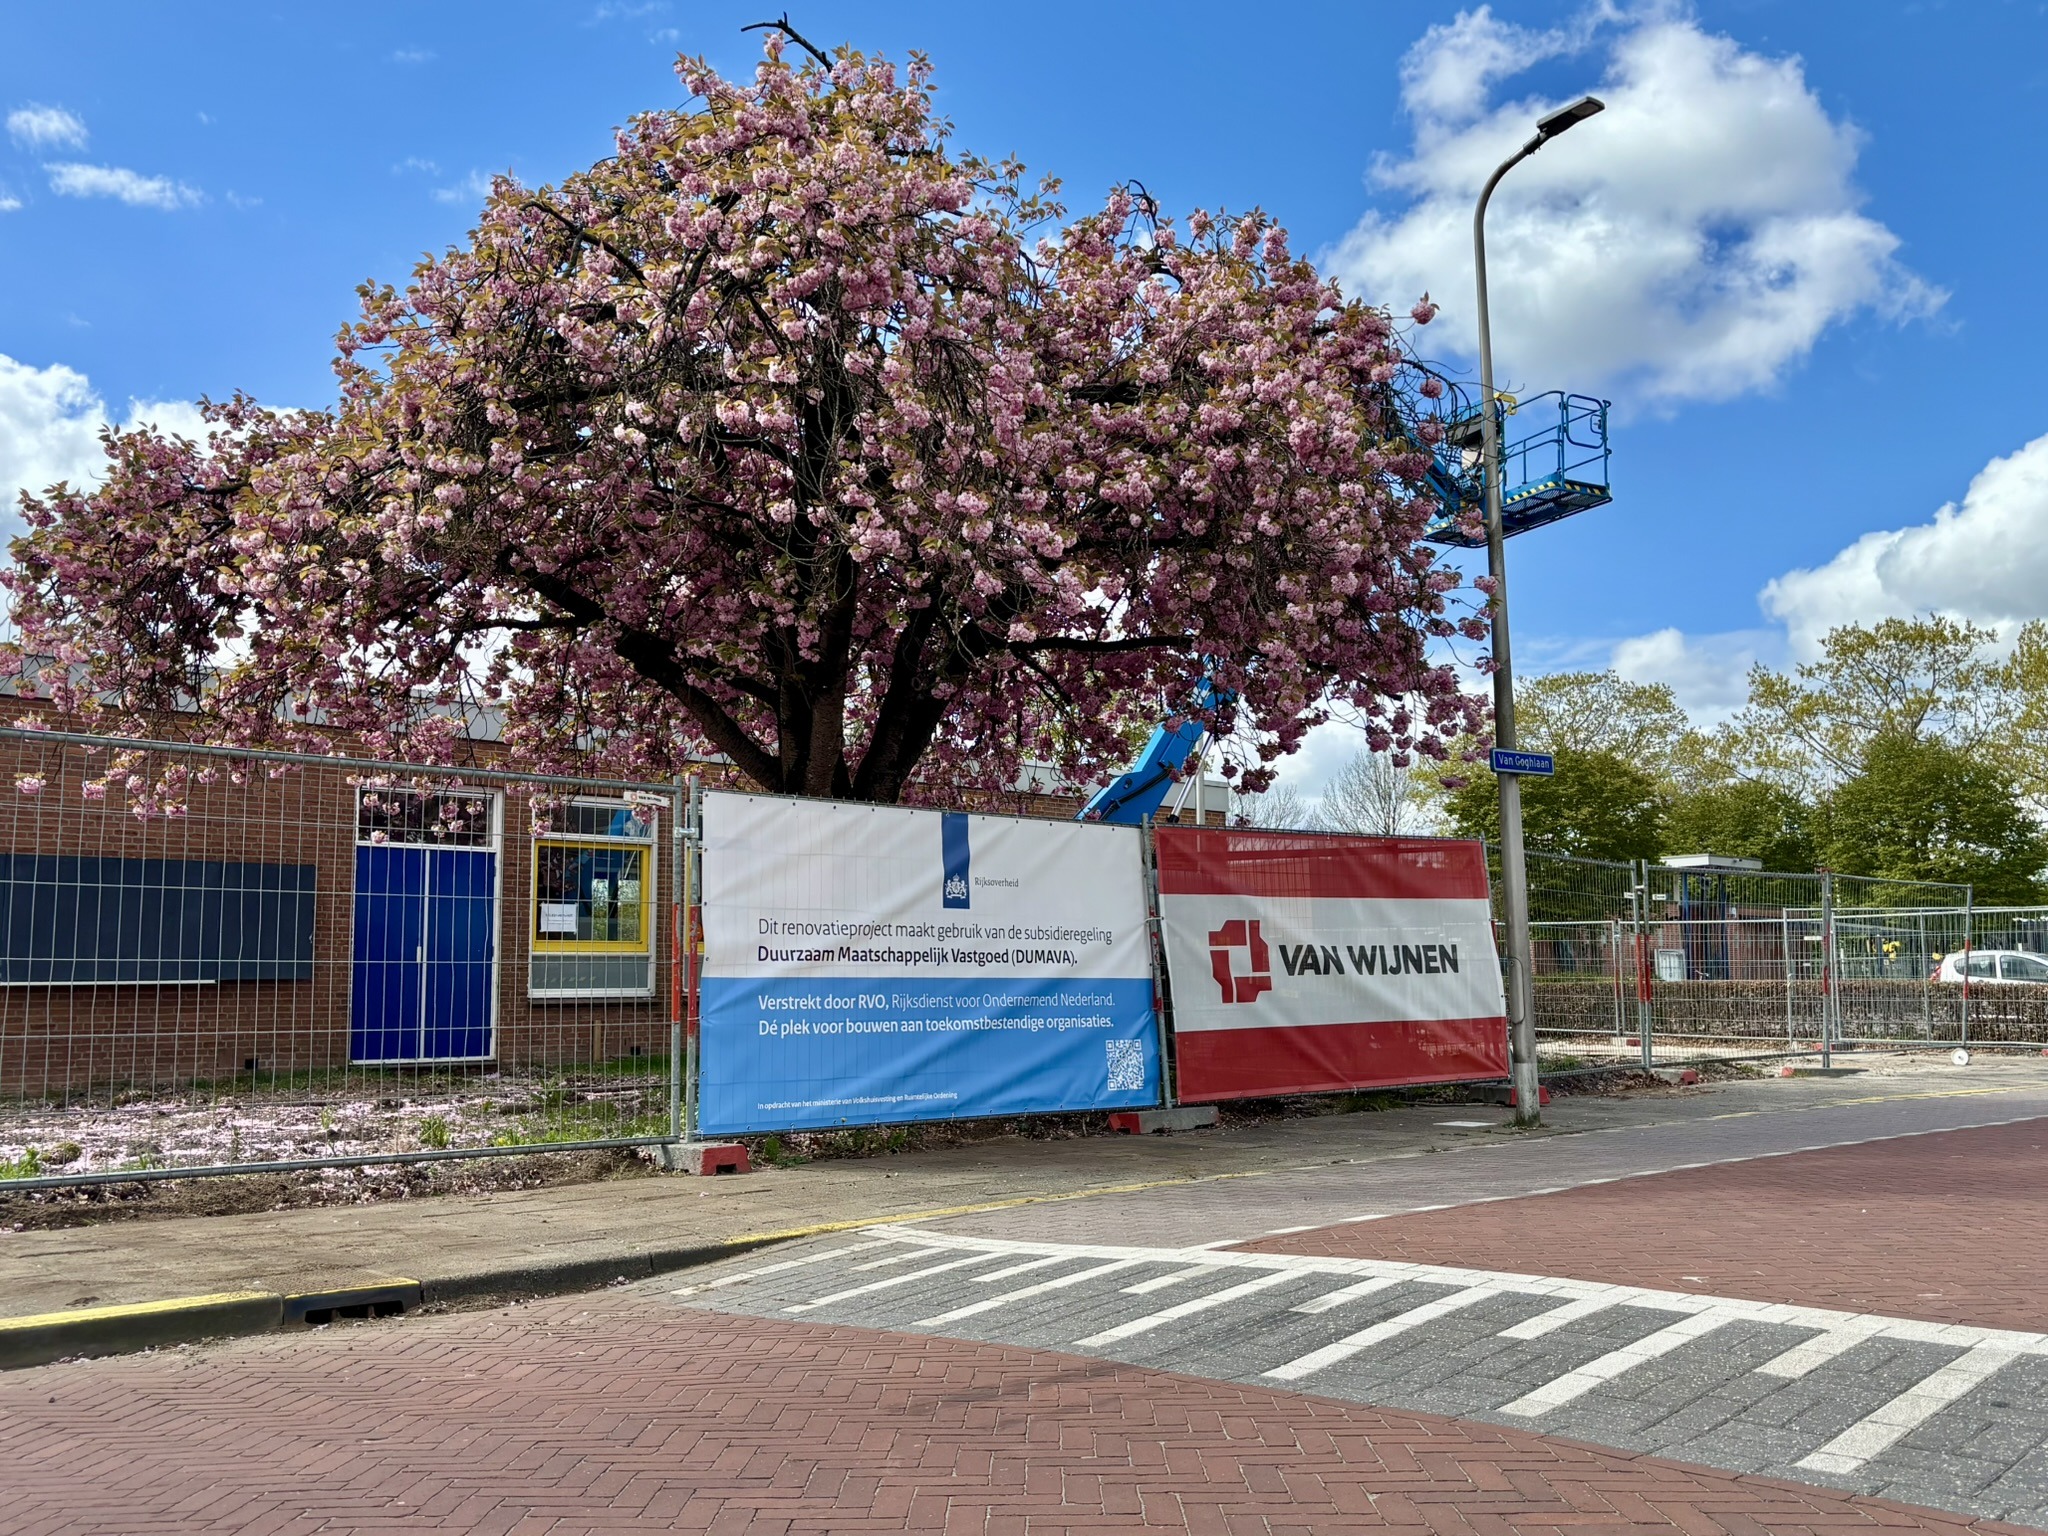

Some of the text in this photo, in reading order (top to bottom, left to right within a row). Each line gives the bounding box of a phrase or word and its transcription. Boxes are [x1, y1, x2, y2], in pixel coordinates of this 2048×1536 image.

[1498, 753, 1550, 770] Van Goghlaan
[974, 876, 1019, 888] Rijksoverheid
[758, 917, 1112, 945] Dit renovatieproject maakt gebruik van de subsidieregeling
[758, 945, 1078, 967] Duurzaam Maatschappelijk Vastgoed (DUMAVA).
[1278, 944, 1459, 976] VAN WIJNEN
[758, 992, 1116, 1012] Verstrekt door RVO, Rijksdienst voor Ondernemend Nederland.
[759, 1014, 1114, 1039] Dé plek voor bouwen aan toekomstbestendige organisaties.
[757, 1102, 764, 1110] In
[764, 1101, 791, 1110] opdracht
[802, 1099, 812, 1107] het
[813, 1098, 841, 1107] ministerie
